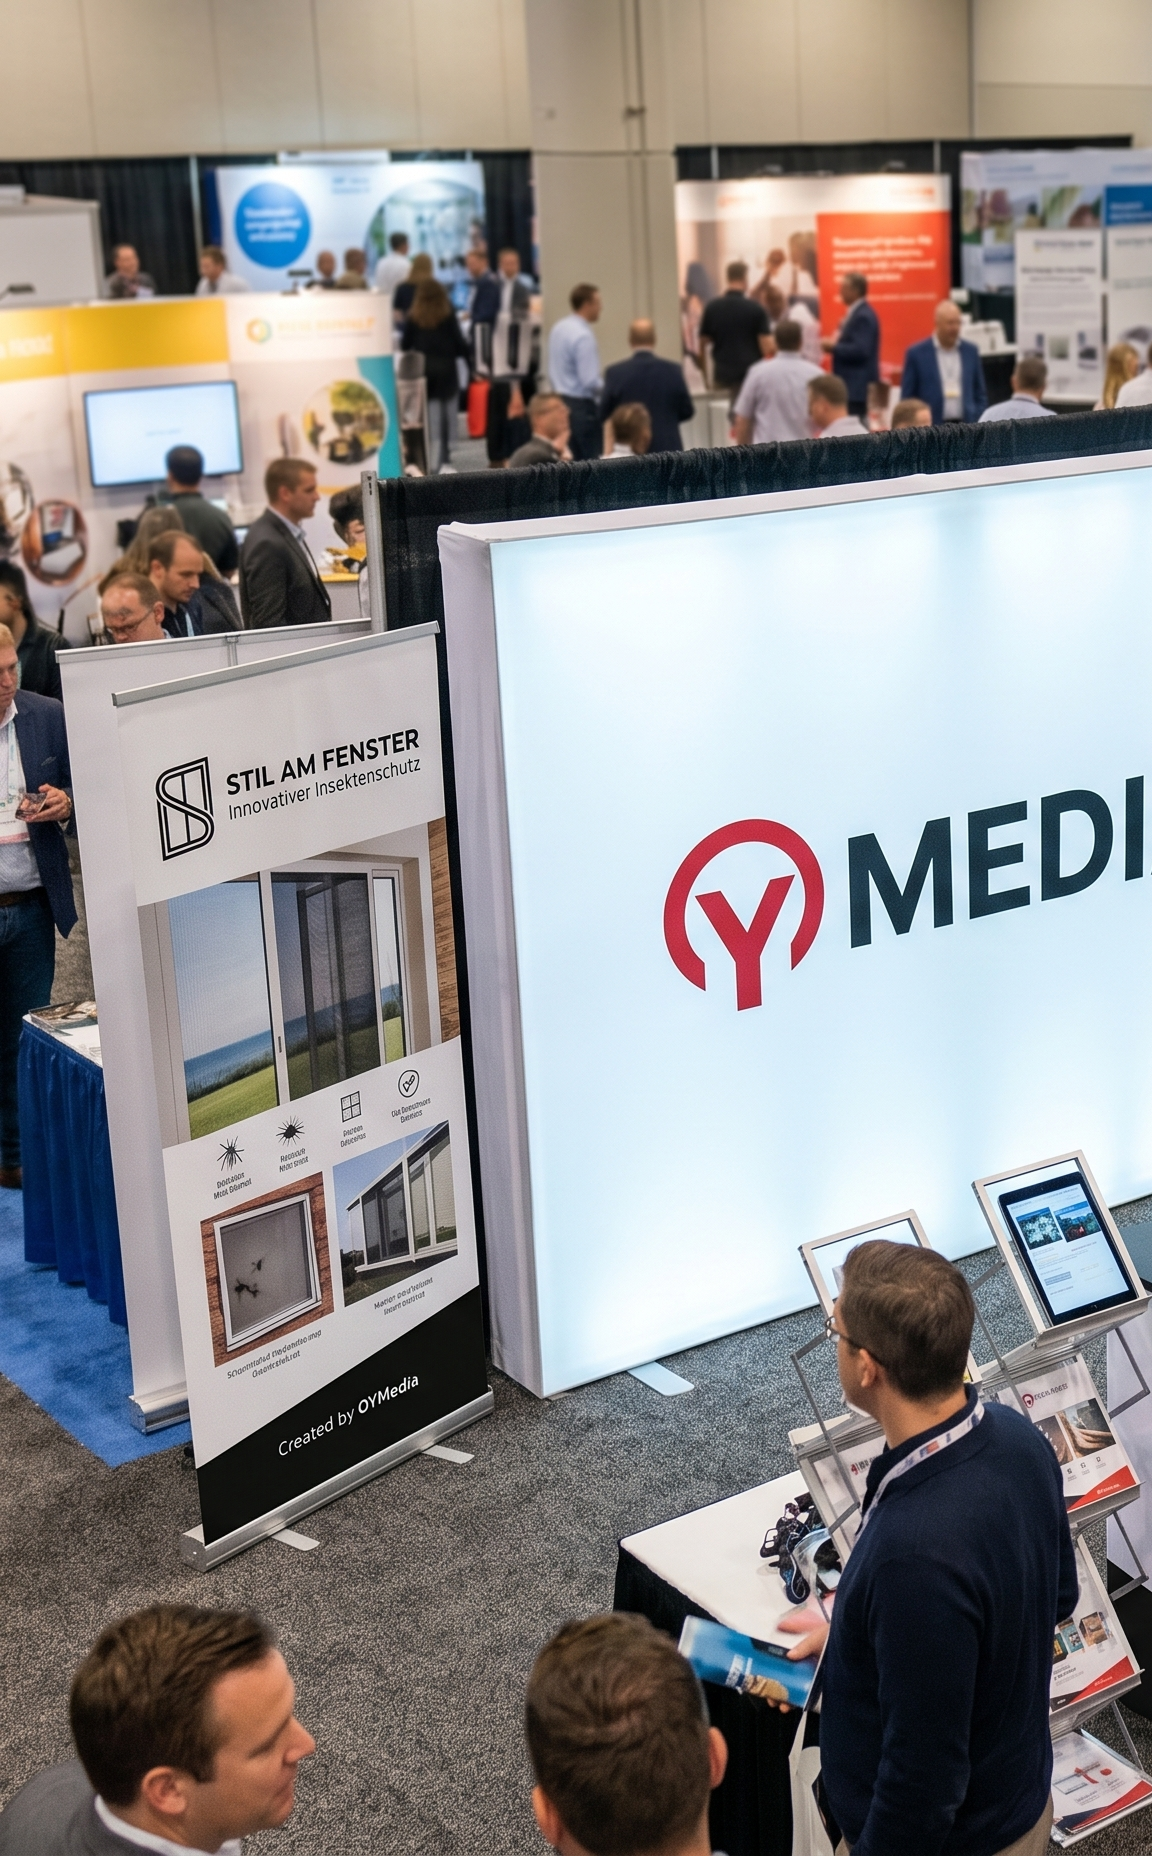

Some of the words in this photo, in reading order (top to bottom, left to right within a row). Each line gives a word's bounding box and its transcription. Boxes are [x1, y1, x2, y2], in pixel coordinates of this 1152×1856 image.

[226, 765, 275, 796] STIL
[280, 753, 316, 783] AM
[322, 728, 420, 771] FENSTER
[228, 786, 311, 820] Innovativer
[315, 758, 421, 797] Insektenschutz
[278, 1416, 334, 1457] Created
[338, 1408, 355, 1427] by
[357, 1375, 420, 1414] OYMedia
